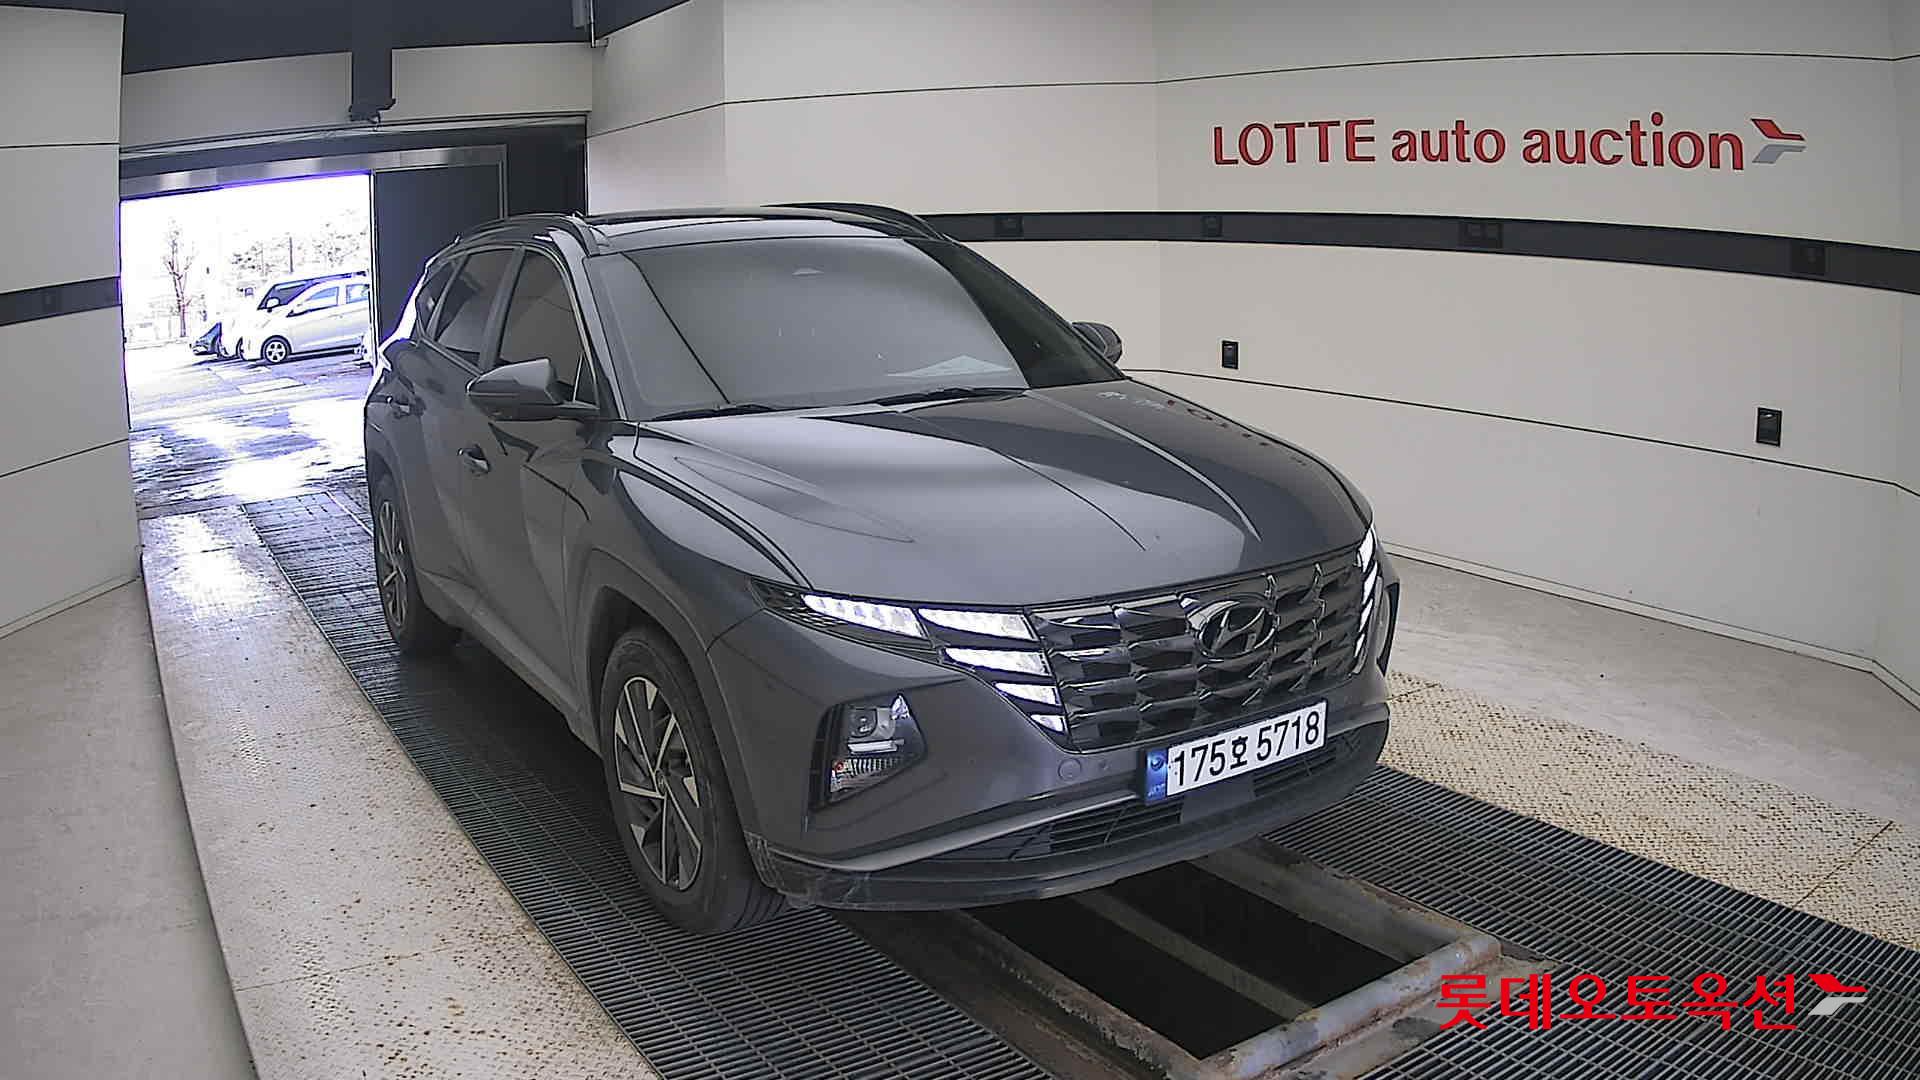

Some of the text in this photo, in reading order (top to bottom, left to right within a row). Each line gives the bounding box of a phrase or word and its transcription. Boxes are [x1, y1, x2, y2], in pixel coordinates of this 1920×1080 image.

[1213, 112, 1745, 171] LOTTE auto auction
[1174, 711, 1320, 786] 175호 5718
